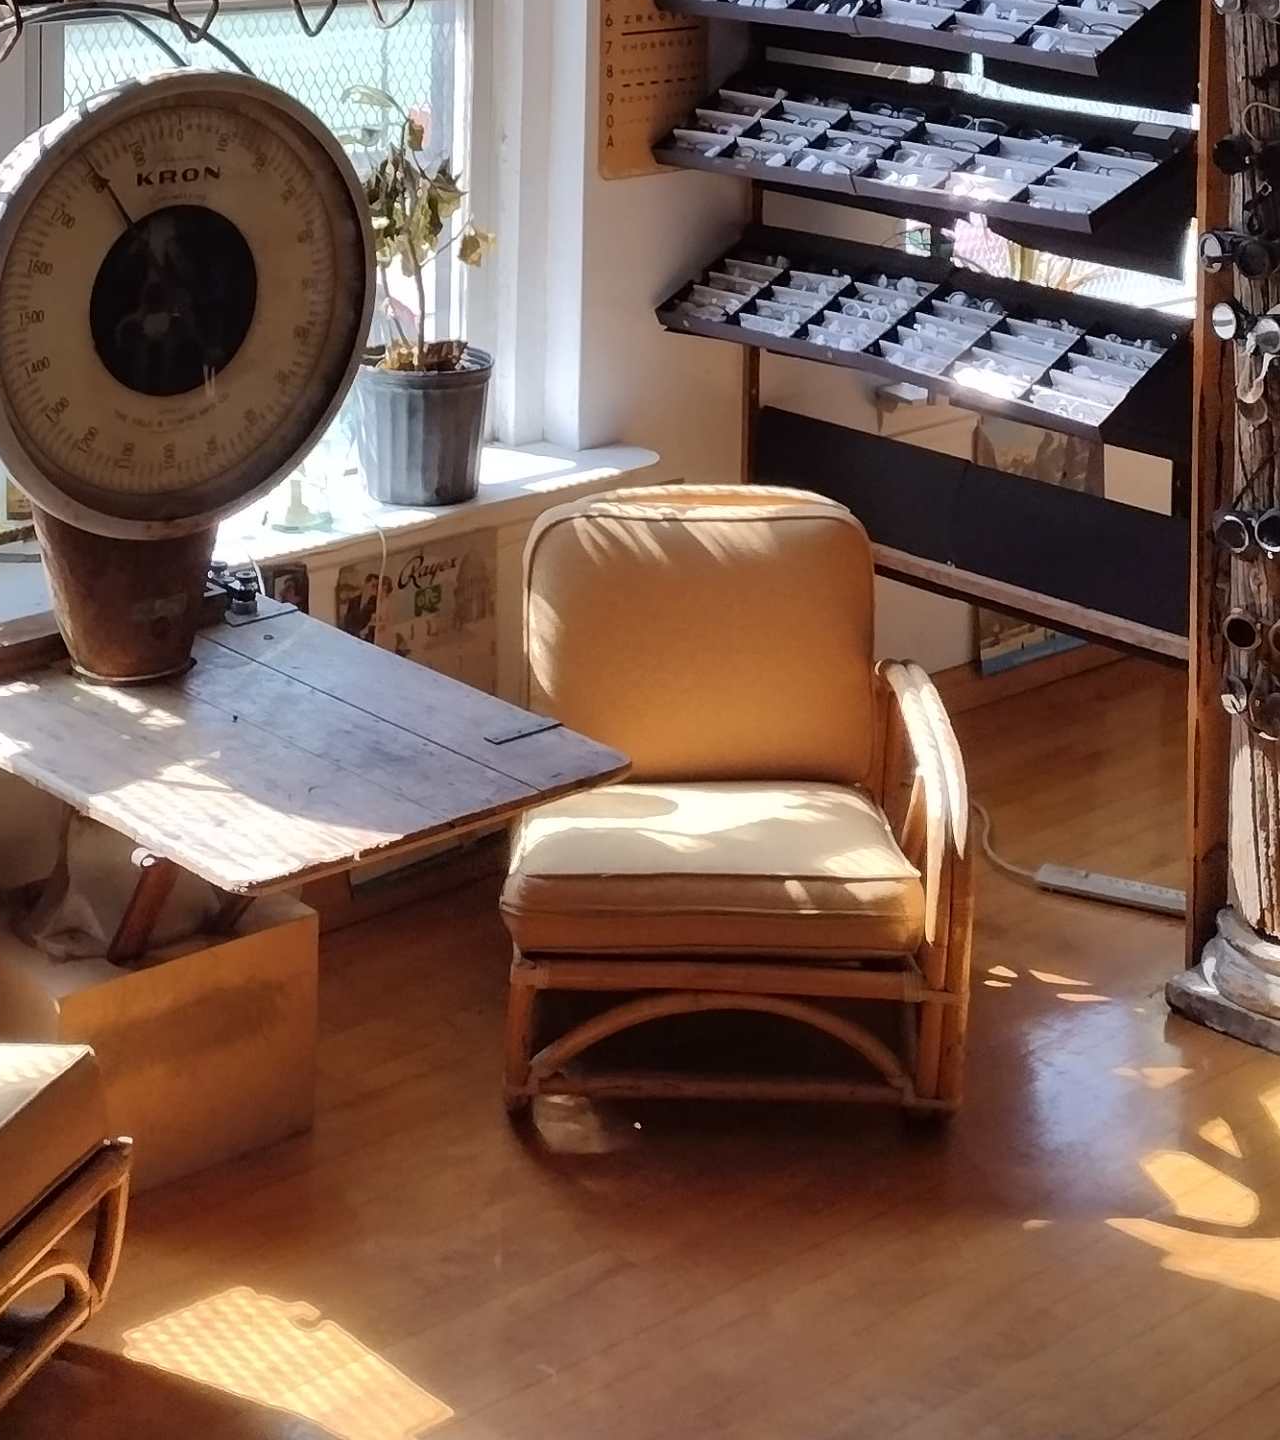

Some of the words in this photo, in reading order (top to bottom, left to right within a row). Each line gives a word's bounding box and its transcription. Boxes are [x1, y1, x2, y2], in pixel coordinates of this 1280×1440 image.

[605, 13, 614, 27] 6
[605, 40, 613, 55] 7
[606, 64, 614, 79] 8
[606, 92, 615, 106] 9
[136, 165, 222, 187] KRON
[50, 207, 76, 230] 1700
[27, 258, 54, 277] 1600
[18, 309, 45, 327] 1500
[24, 356, 51, 379] 1400
[44, 396, 70, 424] 1300
[77, 426, 99, 454] 1200
